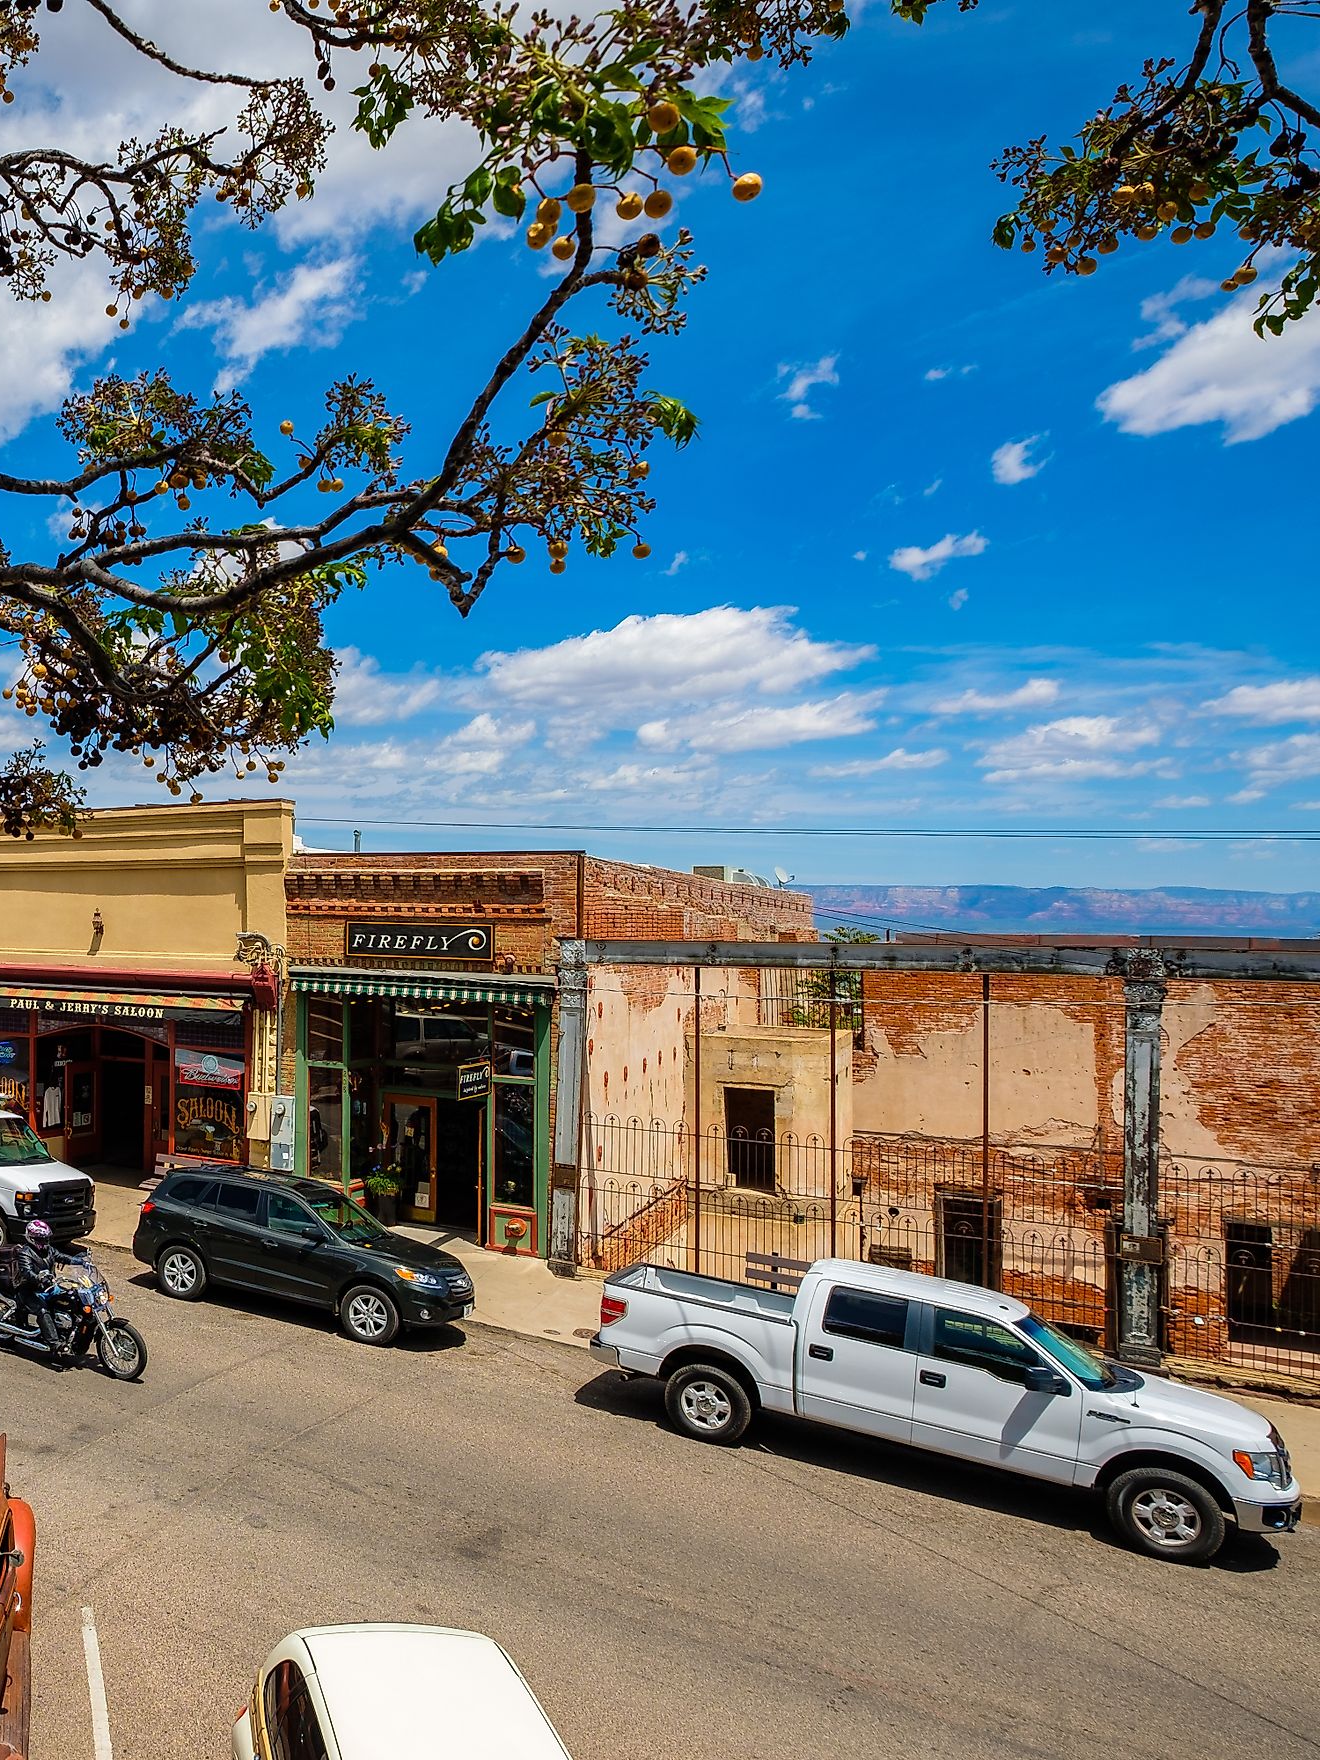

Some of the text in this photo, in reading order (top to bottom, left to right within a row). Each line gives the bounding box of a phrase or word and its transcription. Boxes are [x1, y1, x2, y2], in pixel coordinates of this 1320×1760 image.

[352, 932, 456, 951] FIREFLY
[9, 999, 165, 1019] PAUL & JERRY'S SALOON
[460, 1070, 484, 1084] FIREFLY
[177, 1096, 240, 1134] SALOON
